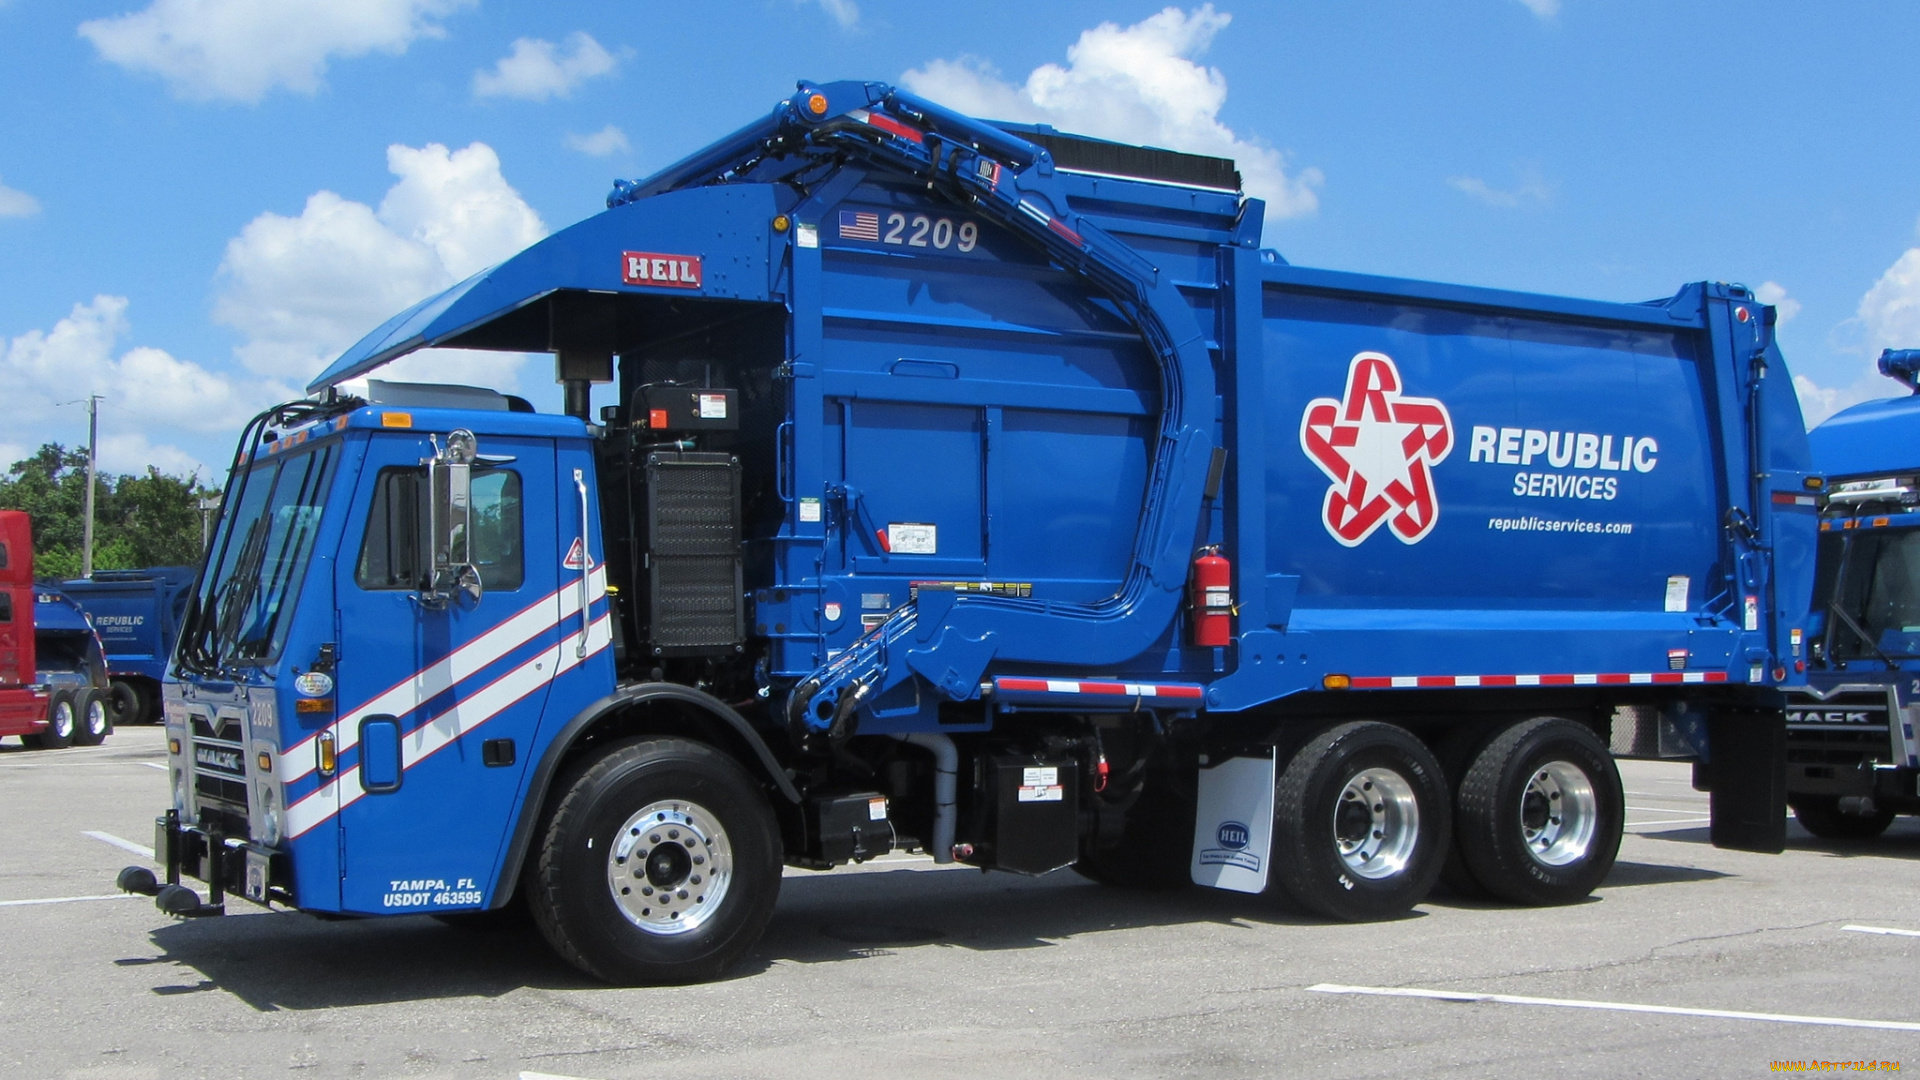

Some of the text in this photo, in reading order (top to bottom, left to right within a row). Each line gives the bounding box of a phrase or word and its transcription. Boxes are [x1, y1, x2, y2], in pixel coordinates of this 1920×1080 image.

[884, 213, 978, 253] 2209
[628, 257, 697, 284] HEIL
[1469, 425, 1658, 473] REPUBLIC
[1512, 472, 1618, 500] SERVICES
[1488, 516, 1633, 535] republicservices.com
[96, 615, 144, 626] REPUBLIC
[252, 702, 273, 728] 2209
[197, 748, 240, 770] MACK
[1220, 829, 1247, 844] HEIL
[390, 878, 476, 892] TAMPA, FL
[383, 891, 482, 907] USDOT 463595
